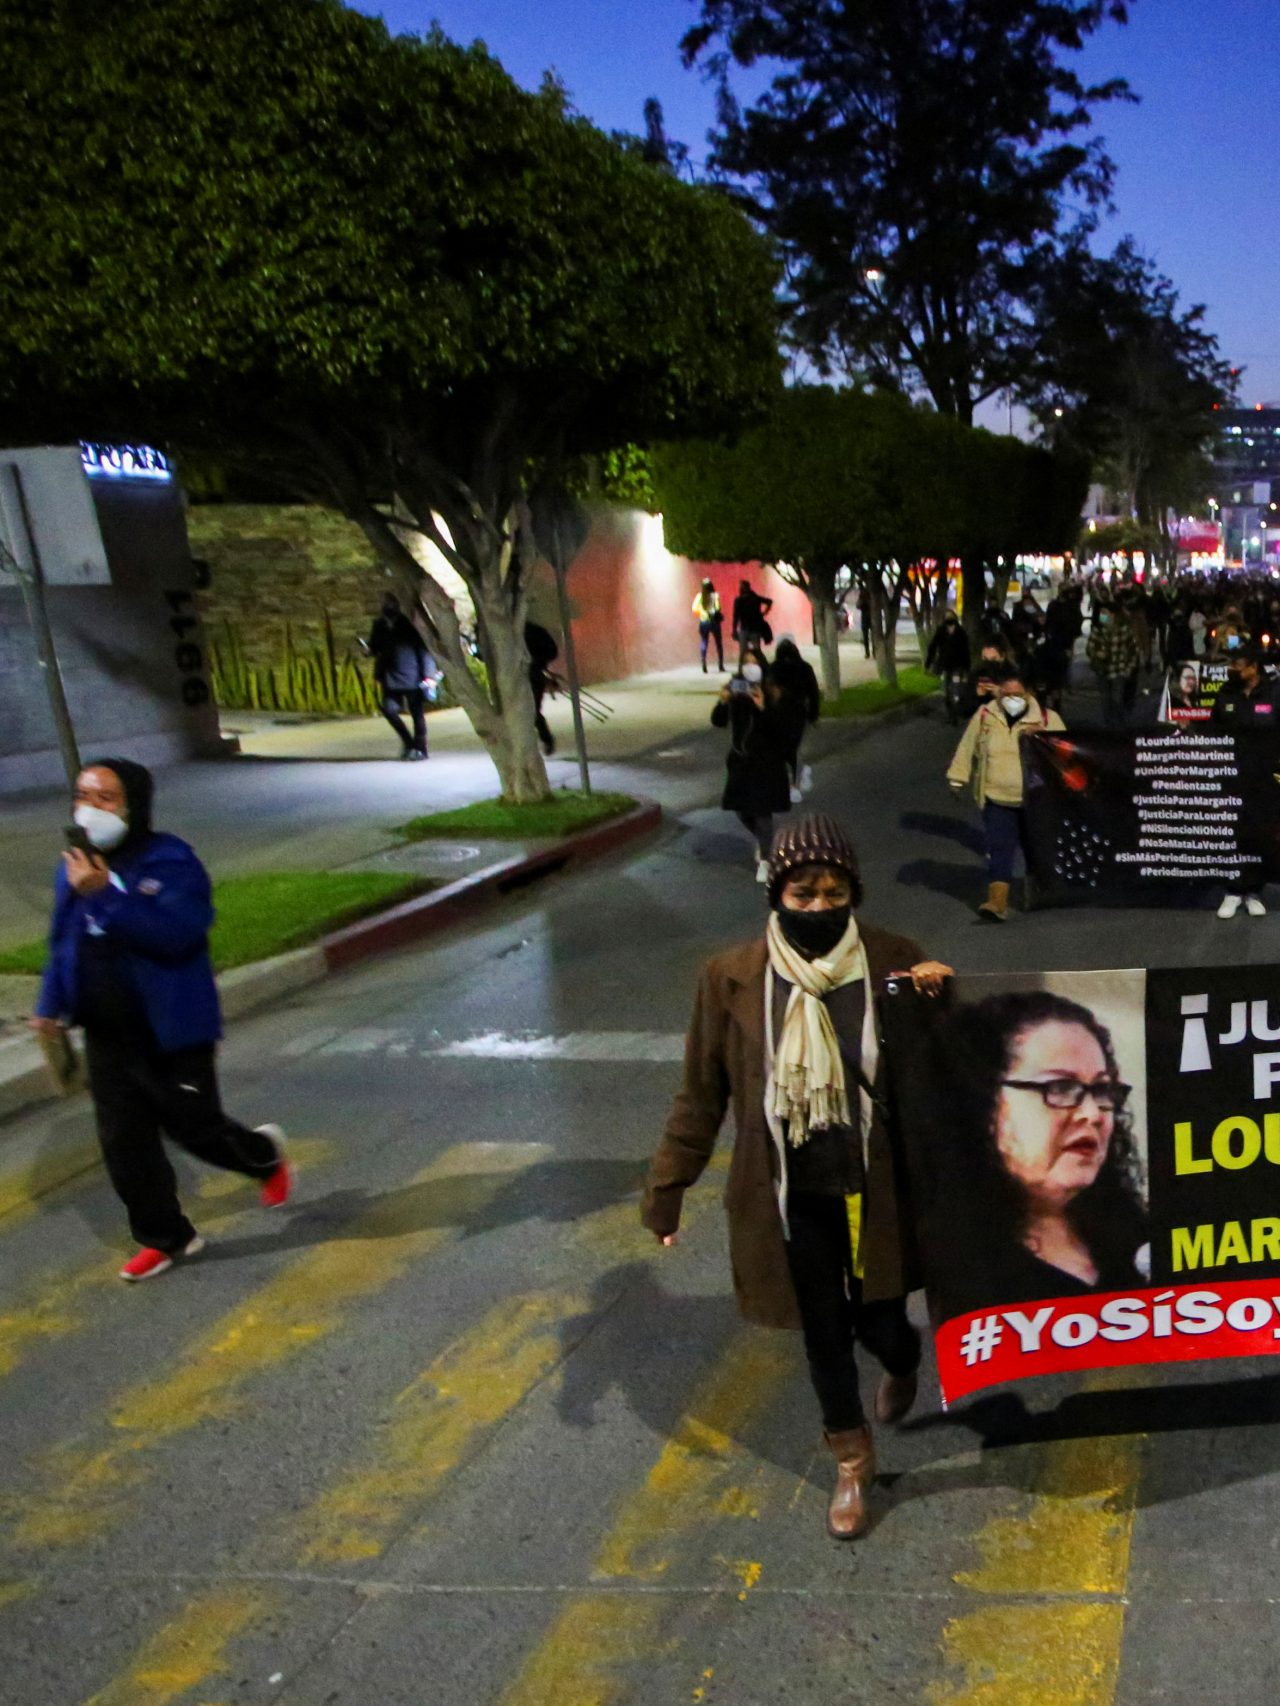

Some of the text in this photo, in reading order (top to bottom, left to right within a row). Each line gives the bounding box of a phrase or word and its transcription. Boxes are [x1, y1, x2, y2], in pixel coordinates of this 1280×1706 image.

[1135, 735, 1235, 747] #LourdesMaldonado
[1134, 765, 1238, 778] #UnidosPorMargarito
[1151, 780, 1222, 791] #Pendientazos
[1132, 794, 1243, 809] #JusticiaParaMargarito
[1138, 809, 1238, 821] #JusticiaParaLourdes
[1140, 823, 1234, 836] #NiSilencioNiOlvido
[1138, 838, 1237, 851] #NoSeMataLaVerdad
[1140, 866, 1241, 880] #PeriodismoEnRiesgo
